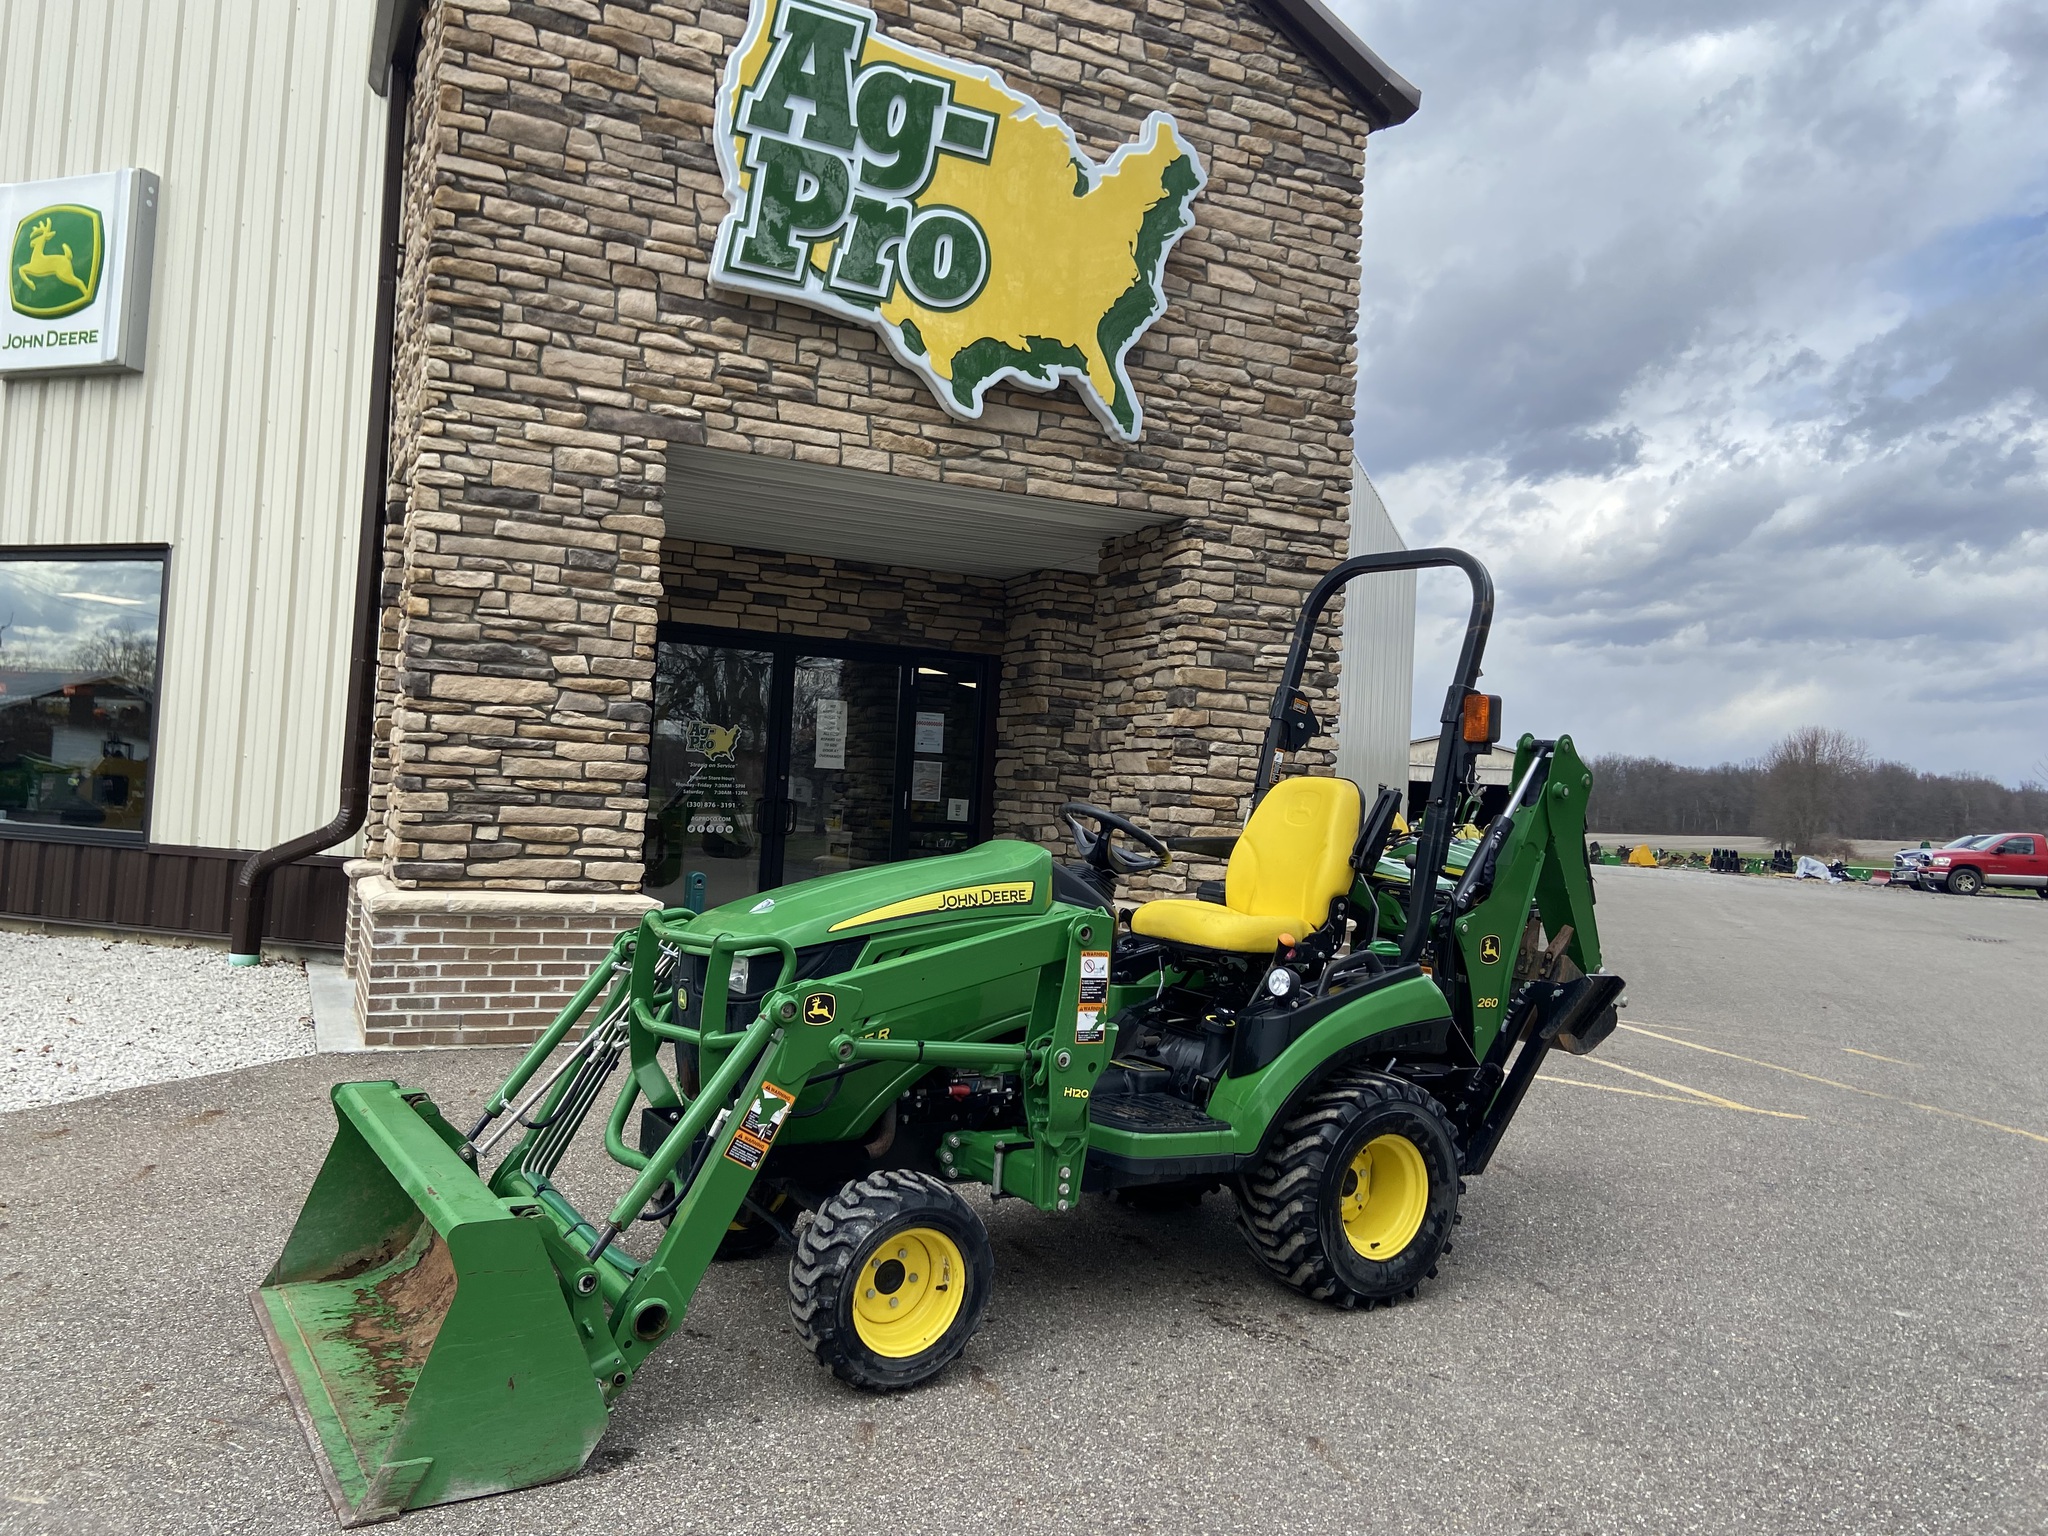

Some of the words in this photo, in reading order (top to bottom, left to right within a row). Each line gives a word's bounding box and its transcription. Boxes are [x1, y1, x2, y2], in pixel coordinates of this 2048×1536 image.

[740, 3, 994, 195] Ag-
[735, 134, 987, 304] Pro
[2, 333, 44, 349] JOHN
[46, 329, 99, 347] DEERE
[689, 723, 715, 739] Ag-
[688, 736, 715, 749] Pro
[937, 893, 979, 908] JOHN
[981, 889, 1027, 904] DEERE
[1477, 997, 1499, 1008] 260
[770, 1085, 792, 1103] WARNING
[1063, 1086, 1089, 1099] H120
[744, 1135, 765, 1150] WARNING
